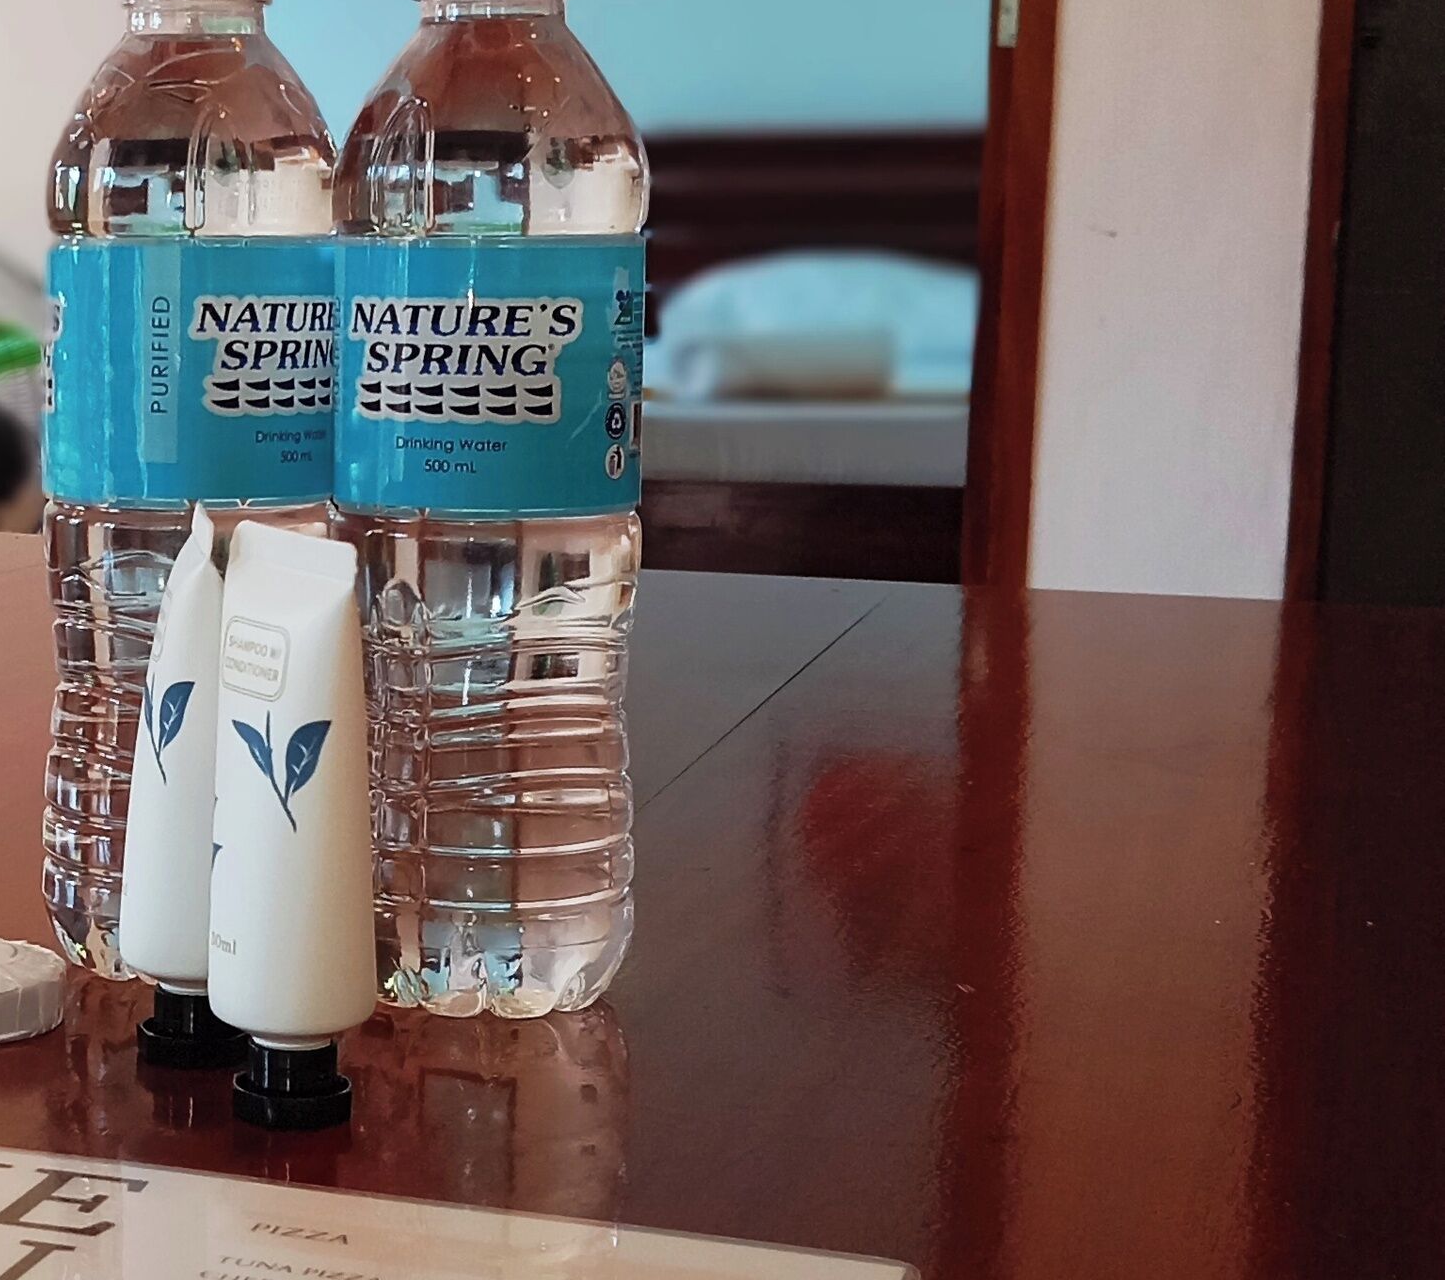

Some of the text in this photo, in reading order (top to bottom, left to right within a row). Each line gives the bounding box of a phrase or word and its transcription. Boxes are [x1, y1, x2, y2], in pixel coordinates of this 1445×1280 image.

[351, 302, 578, 337] NATURE'S
[150, 295, 171, 415] PURIFIED
[220, 338, 335, 371] SPRIN
[366, 340, 548, 377] SPRING
[255, 430, 302, 444] Drinking
[395, 436, 508, 454] Drinking Water
[280, 451, 300, 464] 500
[424, 459, 477, 474] 500 mL
[249, 1223, 352, 1246] PIZZA
[218, 1256, 295, 1274] TUNA
